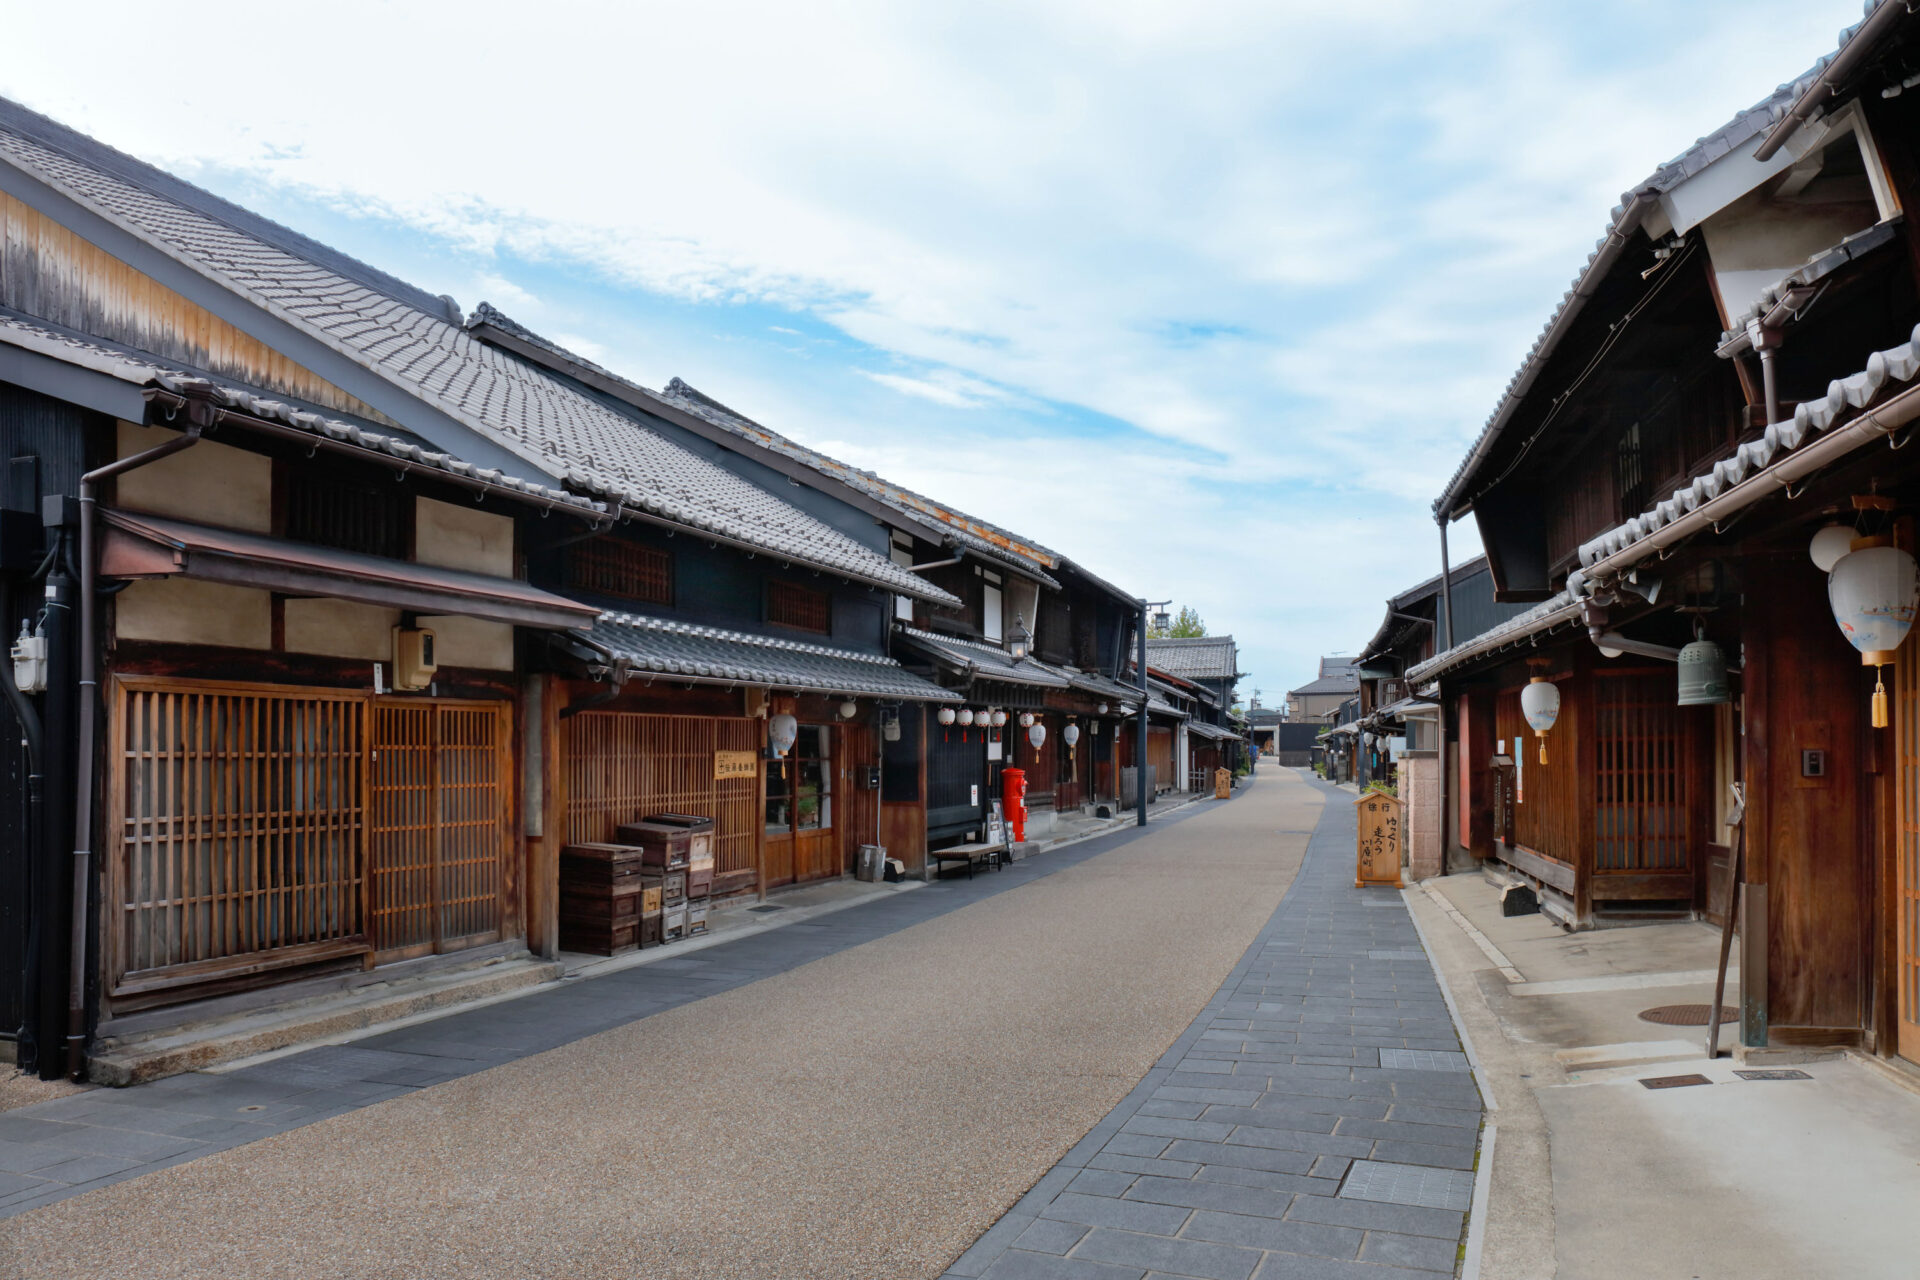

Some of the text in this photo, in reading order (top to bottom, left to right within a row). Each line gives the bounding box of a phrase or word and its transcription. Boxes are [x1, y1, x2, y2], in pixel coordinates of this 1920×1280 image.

[1374, 825, 1385, 855] 走ろう
[1386, 816, 1397, 853] ゆっくり
